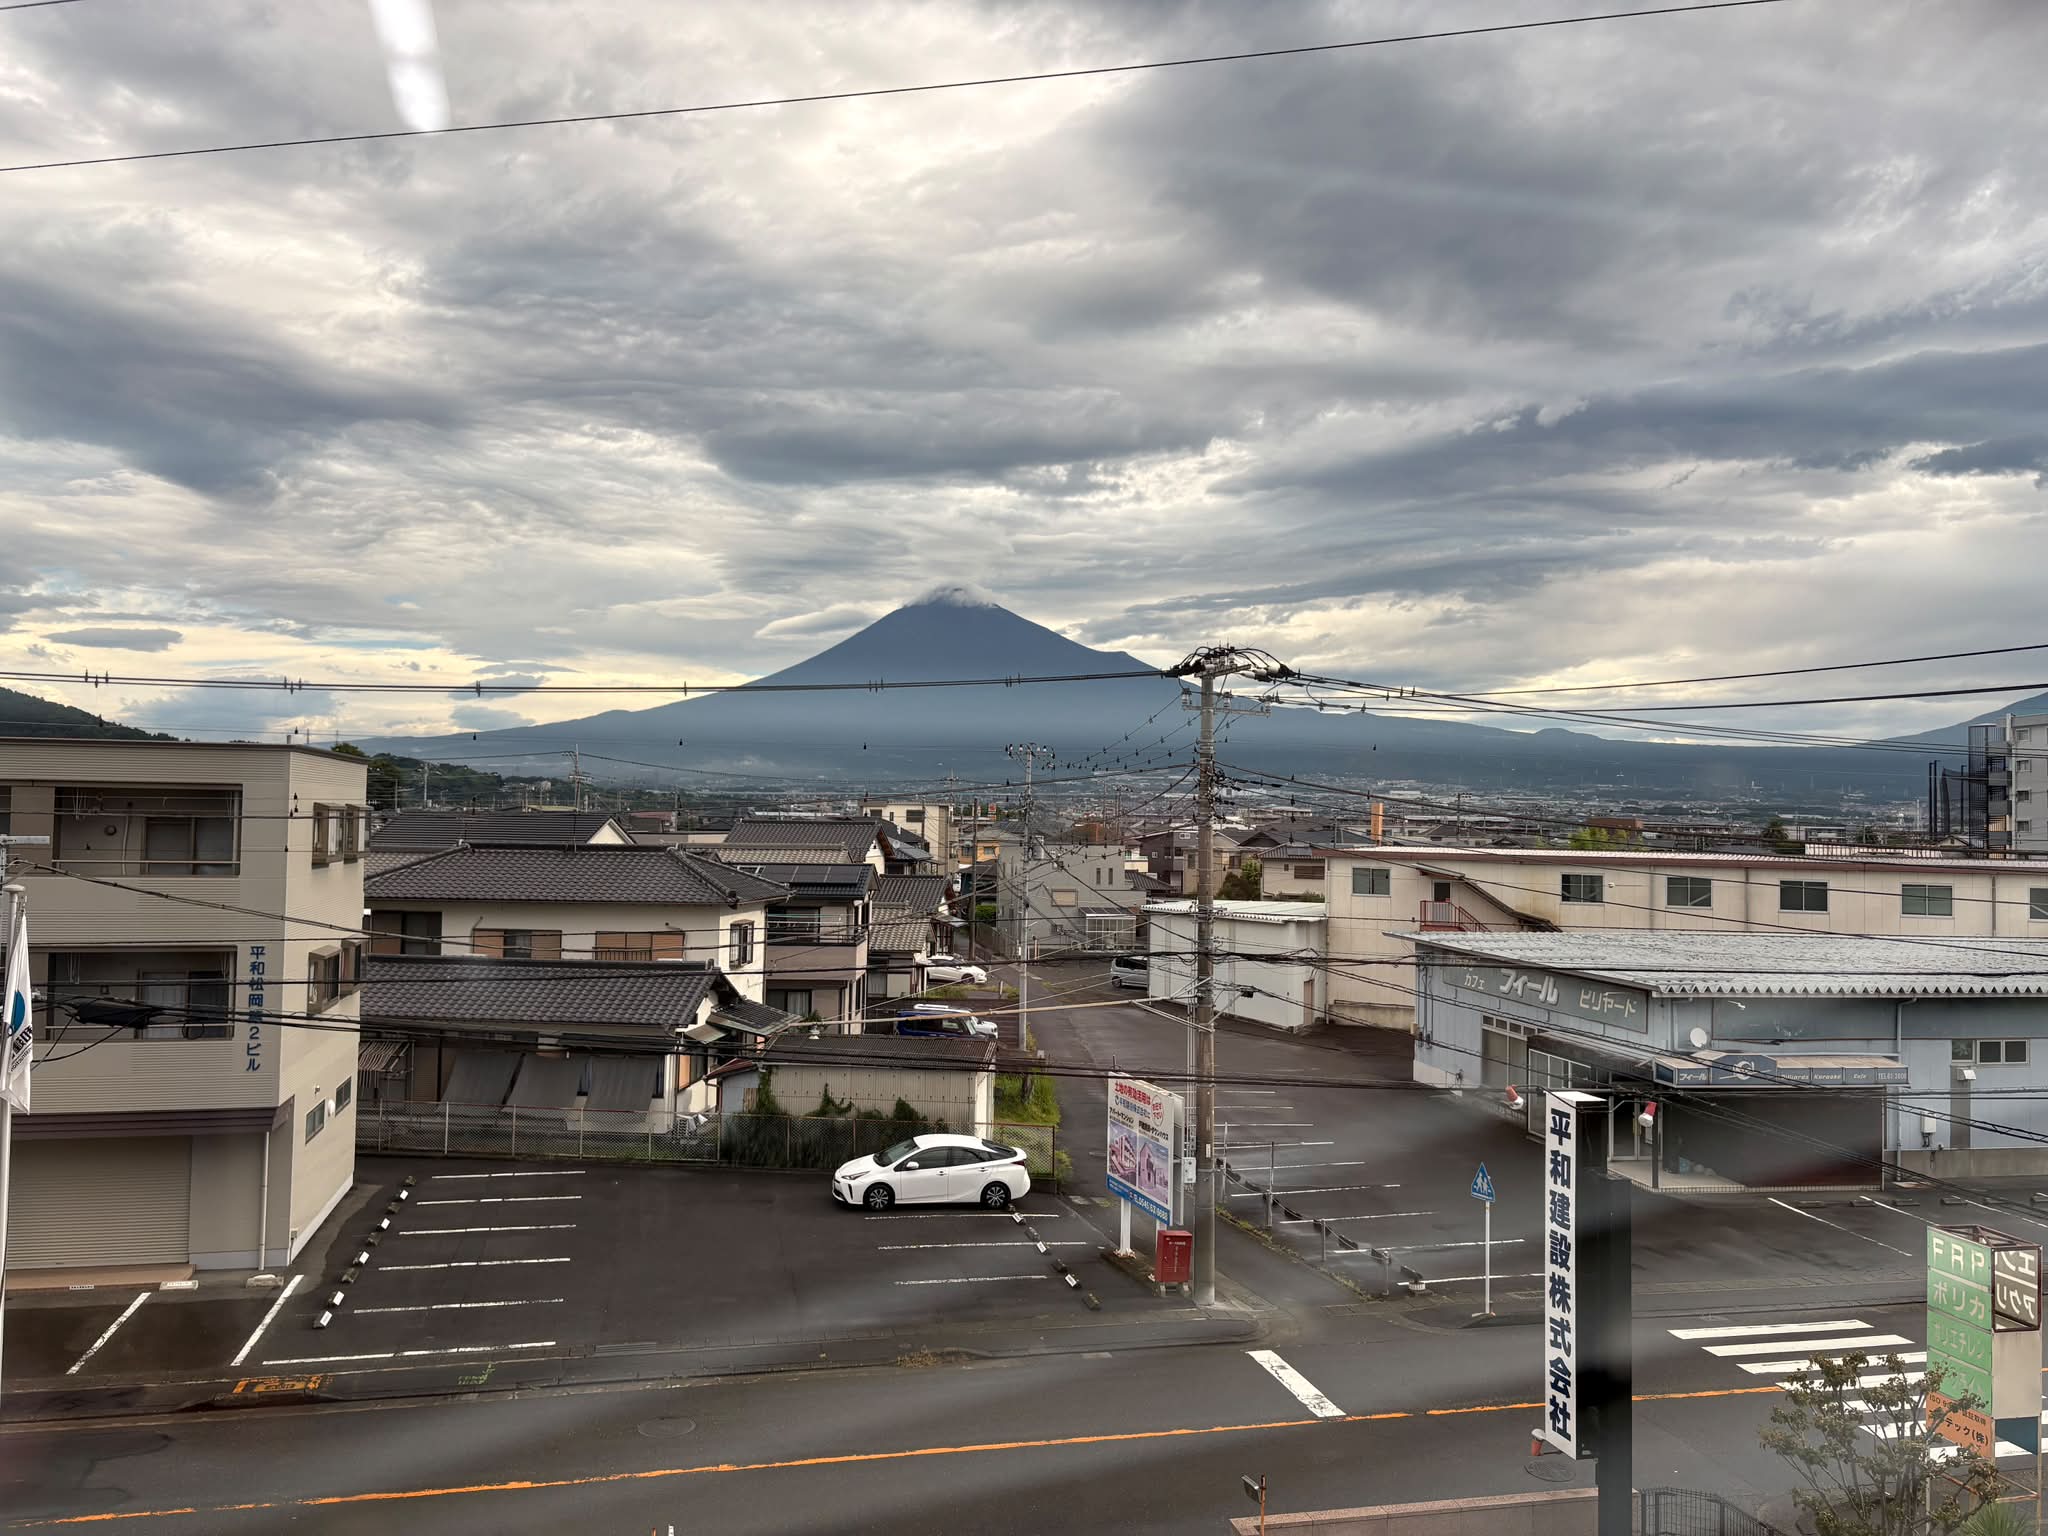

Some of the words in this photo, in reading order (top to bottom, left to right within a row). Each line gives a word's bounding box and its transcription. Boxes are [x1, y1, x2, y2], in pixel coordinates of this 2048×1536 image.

[1499, 968, 1560, 1006] フィール
[1548, 1107, 1572, 1443] 平和建設株式会社
[1933, 1237, 1985, 1278] FRP
[1933, 1281, 1986, 1320] ポリカ
